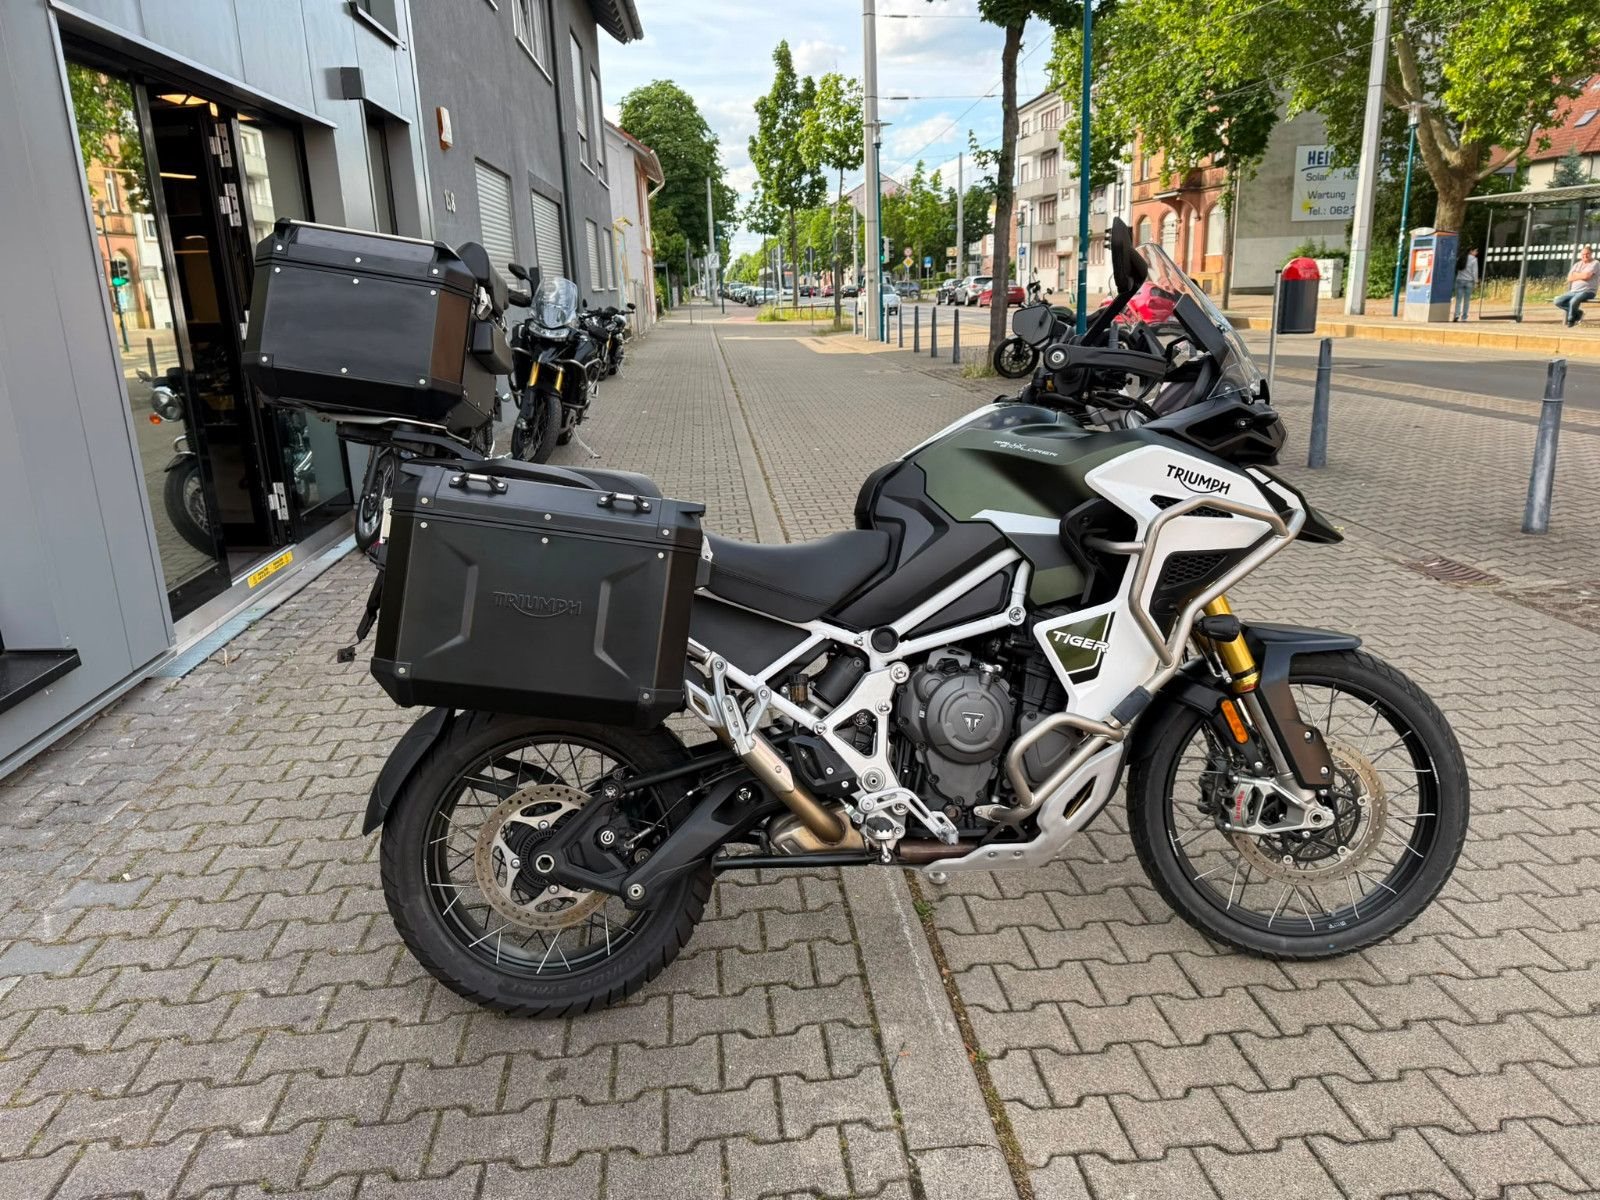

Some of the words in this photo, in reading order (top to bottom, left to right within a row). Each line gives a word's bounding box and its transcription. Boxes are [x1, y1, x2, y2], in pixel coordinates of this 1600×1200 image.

[1306, 172, 1328, 182] Solar
[1307, 190, 1346, 201] Wartung
[1308, 206, 1327, 216] Tel.:
[1000, 444, 1058, 457] EXPLORER
[1167, 464, 1231, 495] TRIUMPH
[491, 591, 582, 618] TRIUMPH
[1053, 630, 1110, 653] TIGER
[1234, 790, 1245, 820] brembo
